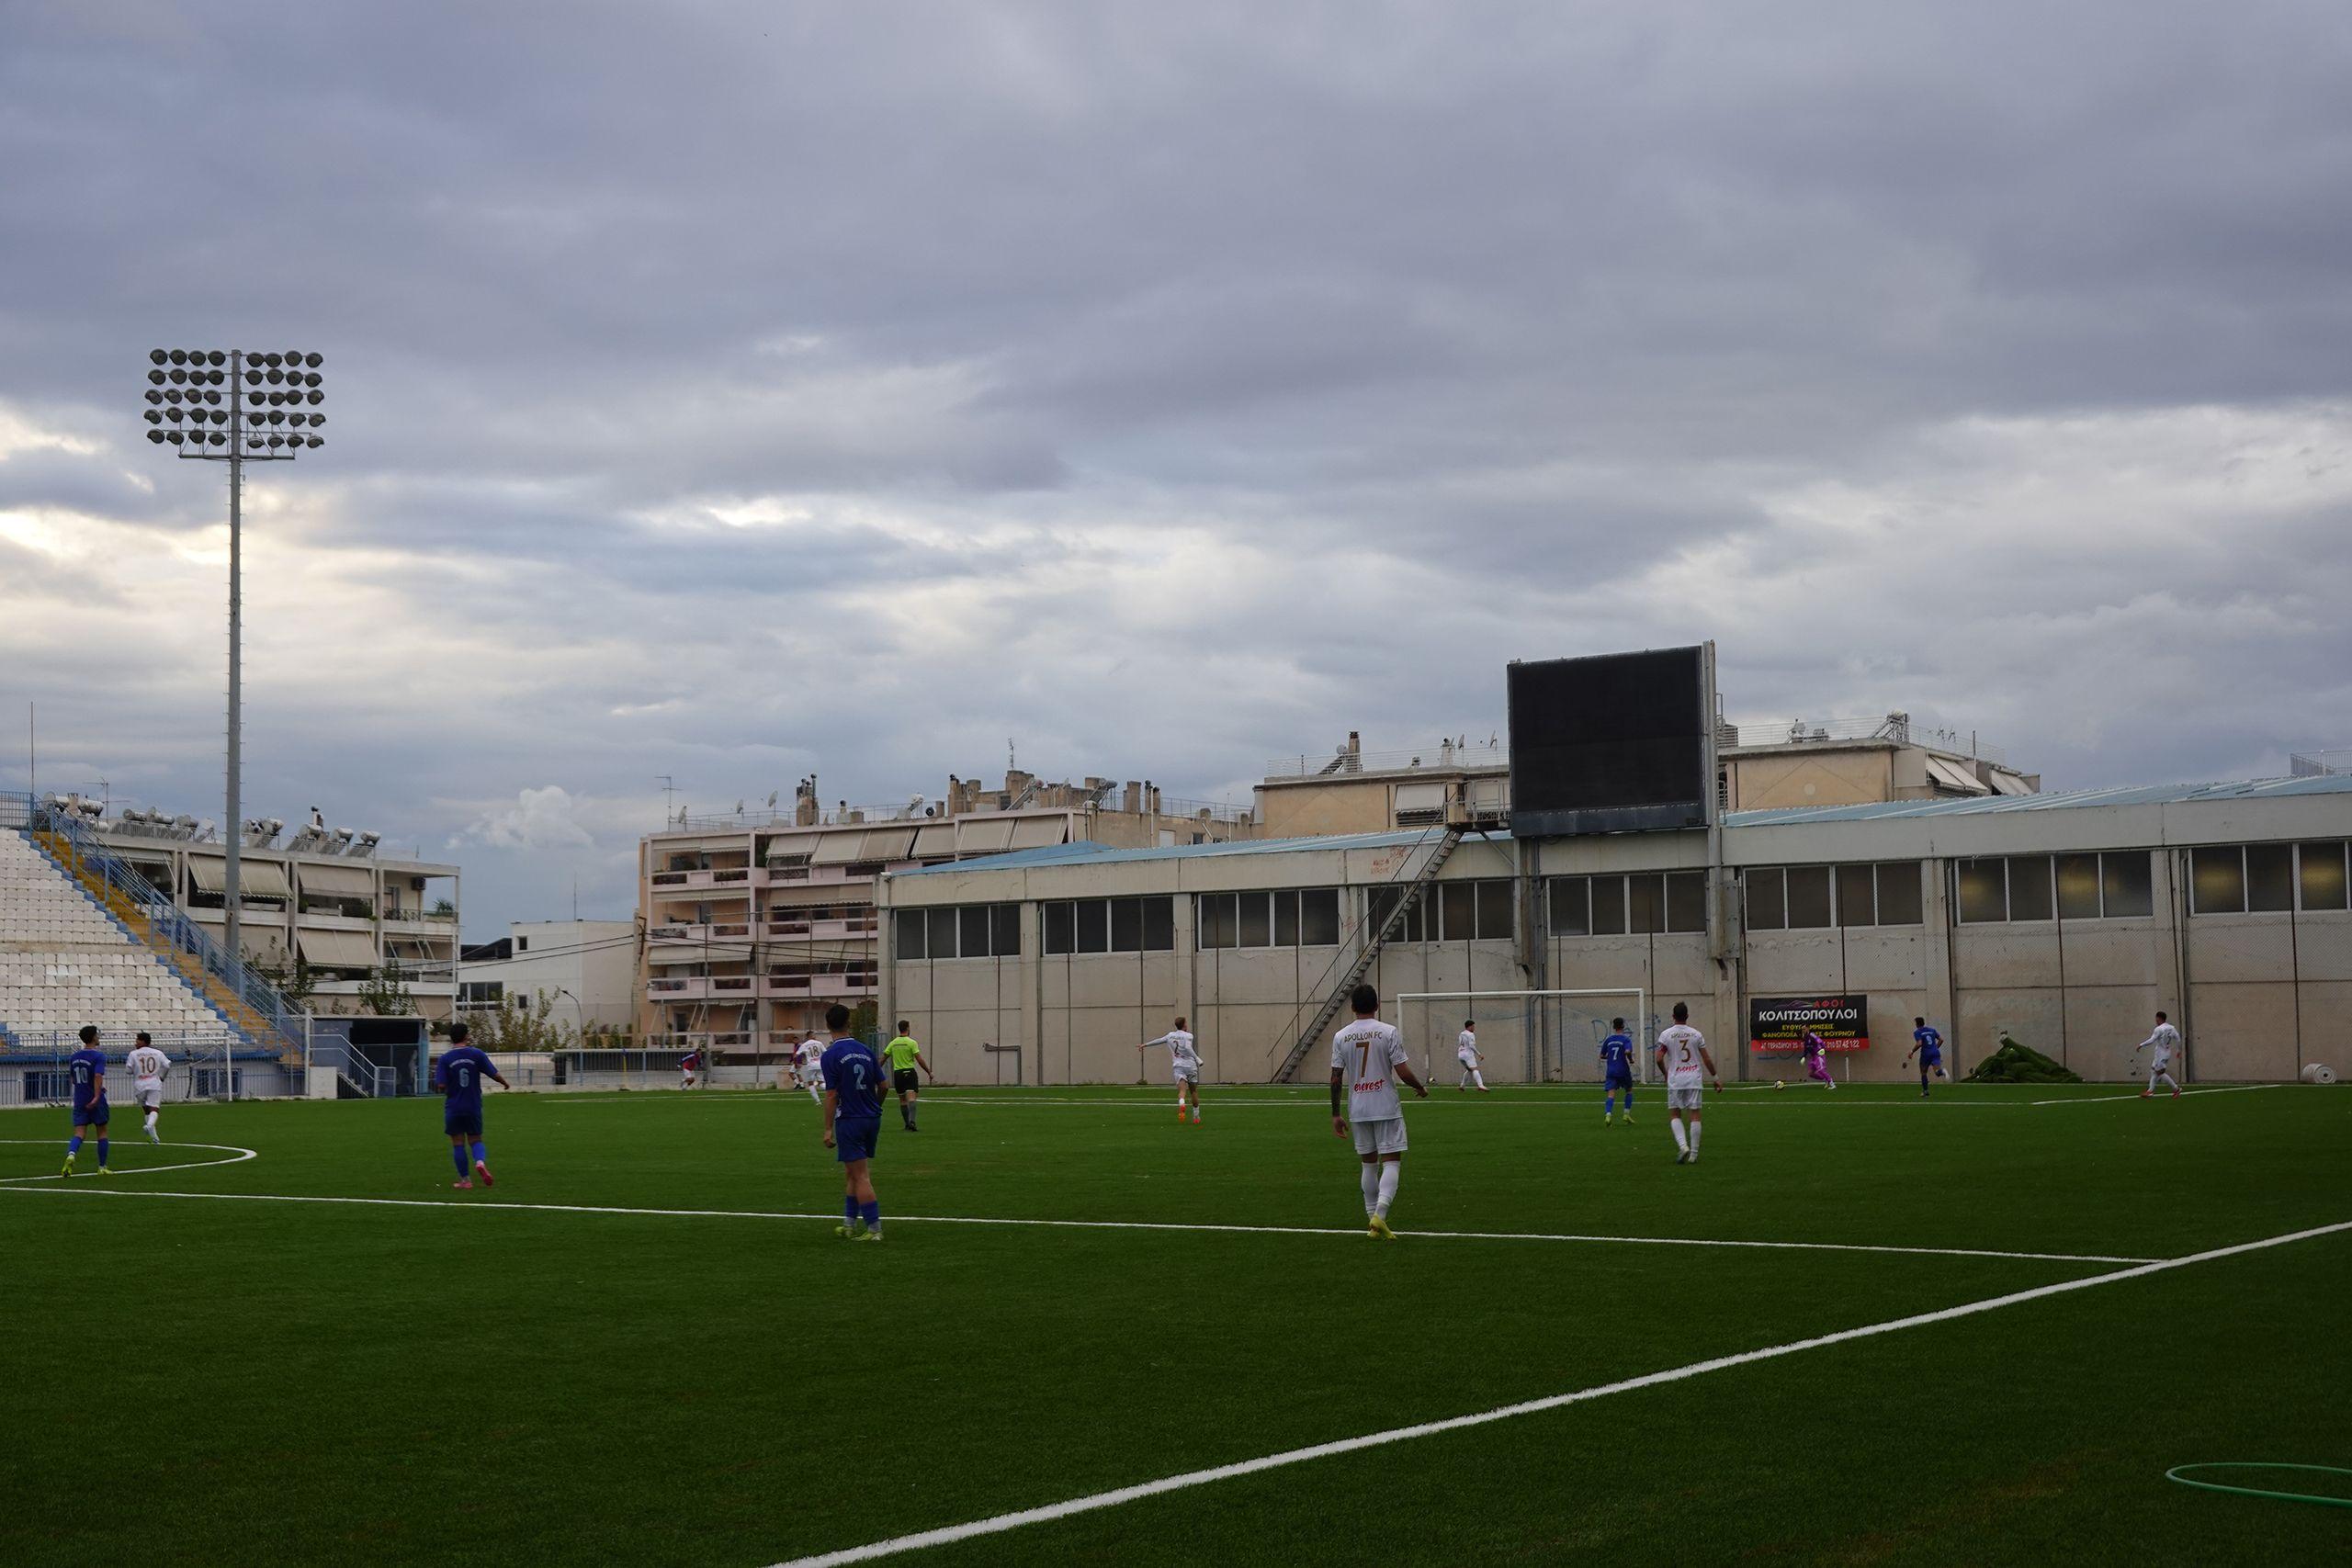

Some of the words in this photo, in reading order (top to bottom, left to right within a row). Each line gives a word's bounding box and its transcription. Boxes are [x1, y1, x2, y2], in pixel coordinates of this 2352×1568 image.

[1758, 1009, 1858, 1021] ΚΟΛΙΤΣΟΠΟΥΛΟΙ
[1344, 1032, 1373, 1043] APOLLON
[1374, 1031, 1383, 1039] FC
[808, 1045, 820, 1058] 18
[1355, 1041, 1370, 1077] 7
[1611, 1046, 1621, 1061] 7
[1679, 1039, 1690, 1063] 3
[139, 1056, 156, 1074] 10
[74, 1066, 88, 1084] 10
[458, 1067, 470, 1088] 6
[854, 1063, 867, 1090] 2
[1353, 1078, 1385, 1092] everest
